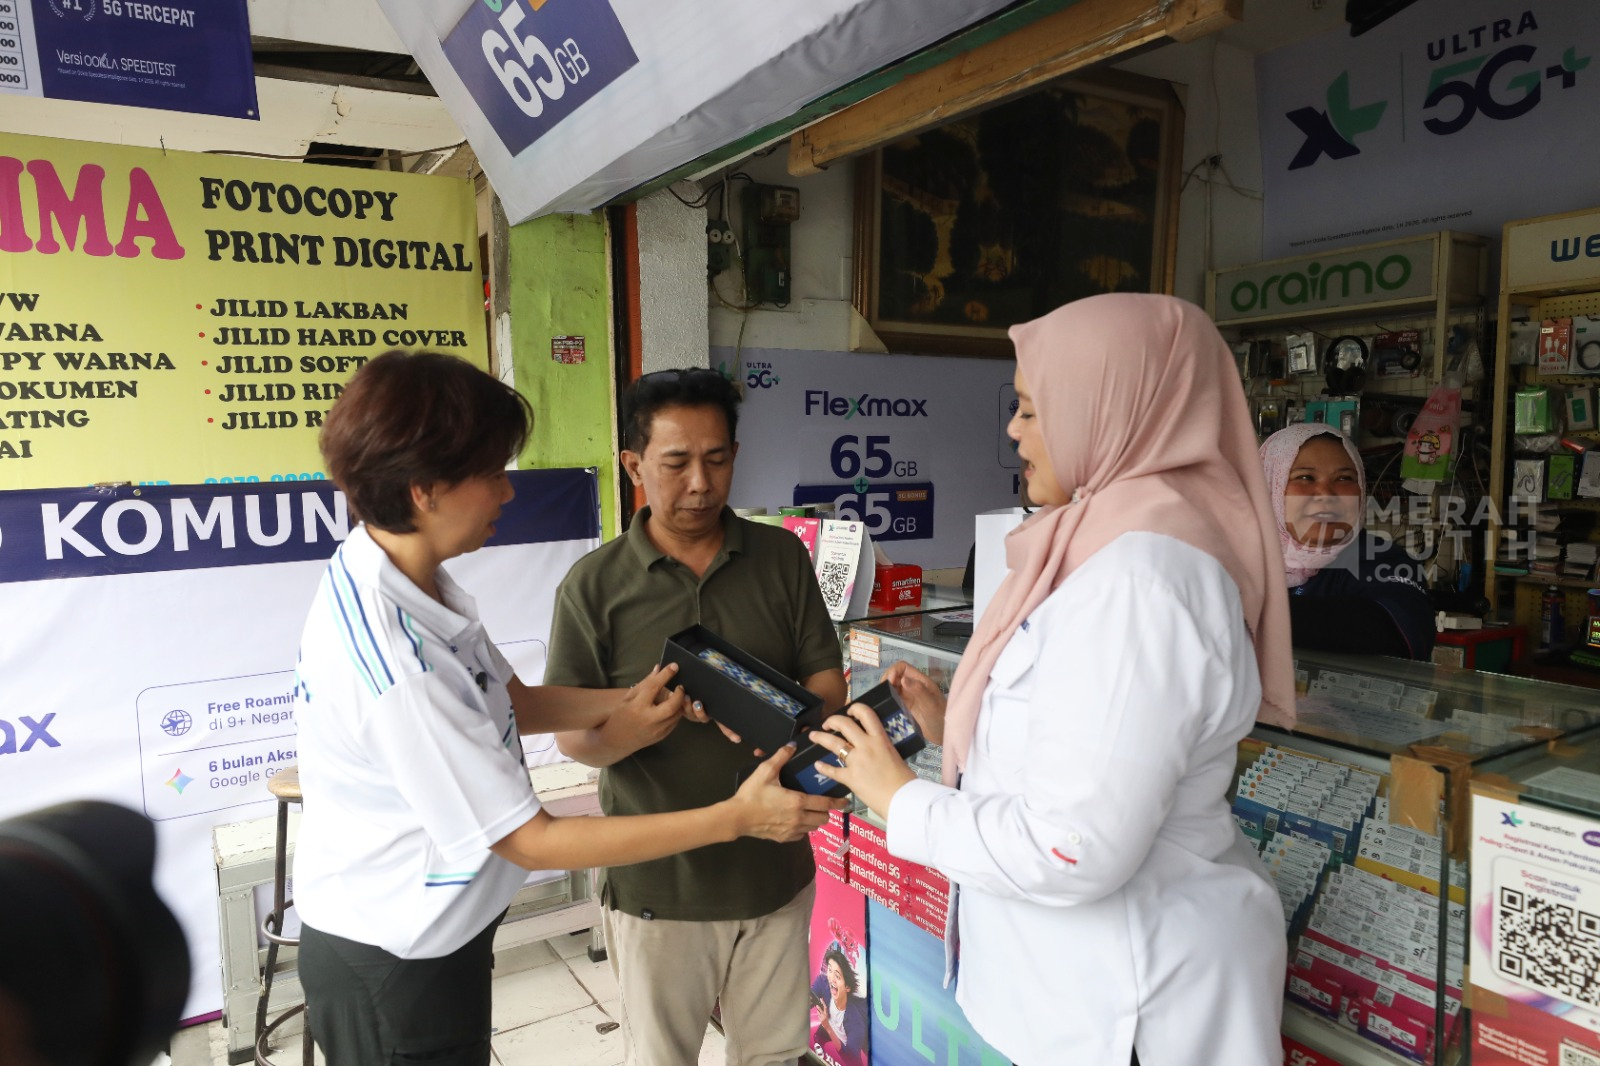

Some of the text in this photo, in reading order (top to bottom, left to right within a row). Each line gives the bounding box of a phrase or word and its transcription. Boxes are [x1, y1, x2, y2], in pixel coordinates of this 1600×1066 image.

[103, 0, 195, 28] 5G TERCEPAT
[1426, 10, 1540, 62] ULTRA
[56, 49, 176, 77] Versi OOKLA SPEEDTEST
[482, 0, 591, 118] 65 GB
[1285, 69, 1389, 171] XL
[200, 176, 398, 221] FOTOCOPY
[204, 229, 473, 272] PRINT DIGITAL
[1230, 254, 1412, 313] oraimo
[210, 298, 408, 320] JILID LAKBAN
[0, 322, 104, 342] ARNA
[213, 327, 468, 347] JILID HARD COVER
[53, 352, 176, 371] WARNA
[216, 355, 368, 374] JILID SOFT
[0, 380, 138, 400] OKUMEN
[219, 383, 296, 402] JILID
[805, 390, 928, 420] Flexmax
[222, 411, 298, 430] JILID
[830, 434, 918, 479] 65 GB
[41, 491, 349, 560] KOMUN
[893, 517, 917, 533] GB
[208, 700, 241, 715] Free
[209, 718, 223, 731] di
[208, 760, 218, 773] 6
[222, 755, 263, 771] bulan
[209, 771, 260, 789] Google
[849, 822, 887, 849] smartfren
[849, 844, 887, 873] smartfren
[888, 862, 900, 880] 5G
[849, 862, 900, 897] smartfren 5G
[1521, 870, 1549, 884] Scan
[1525, 881, 1577, 902] registrasi
